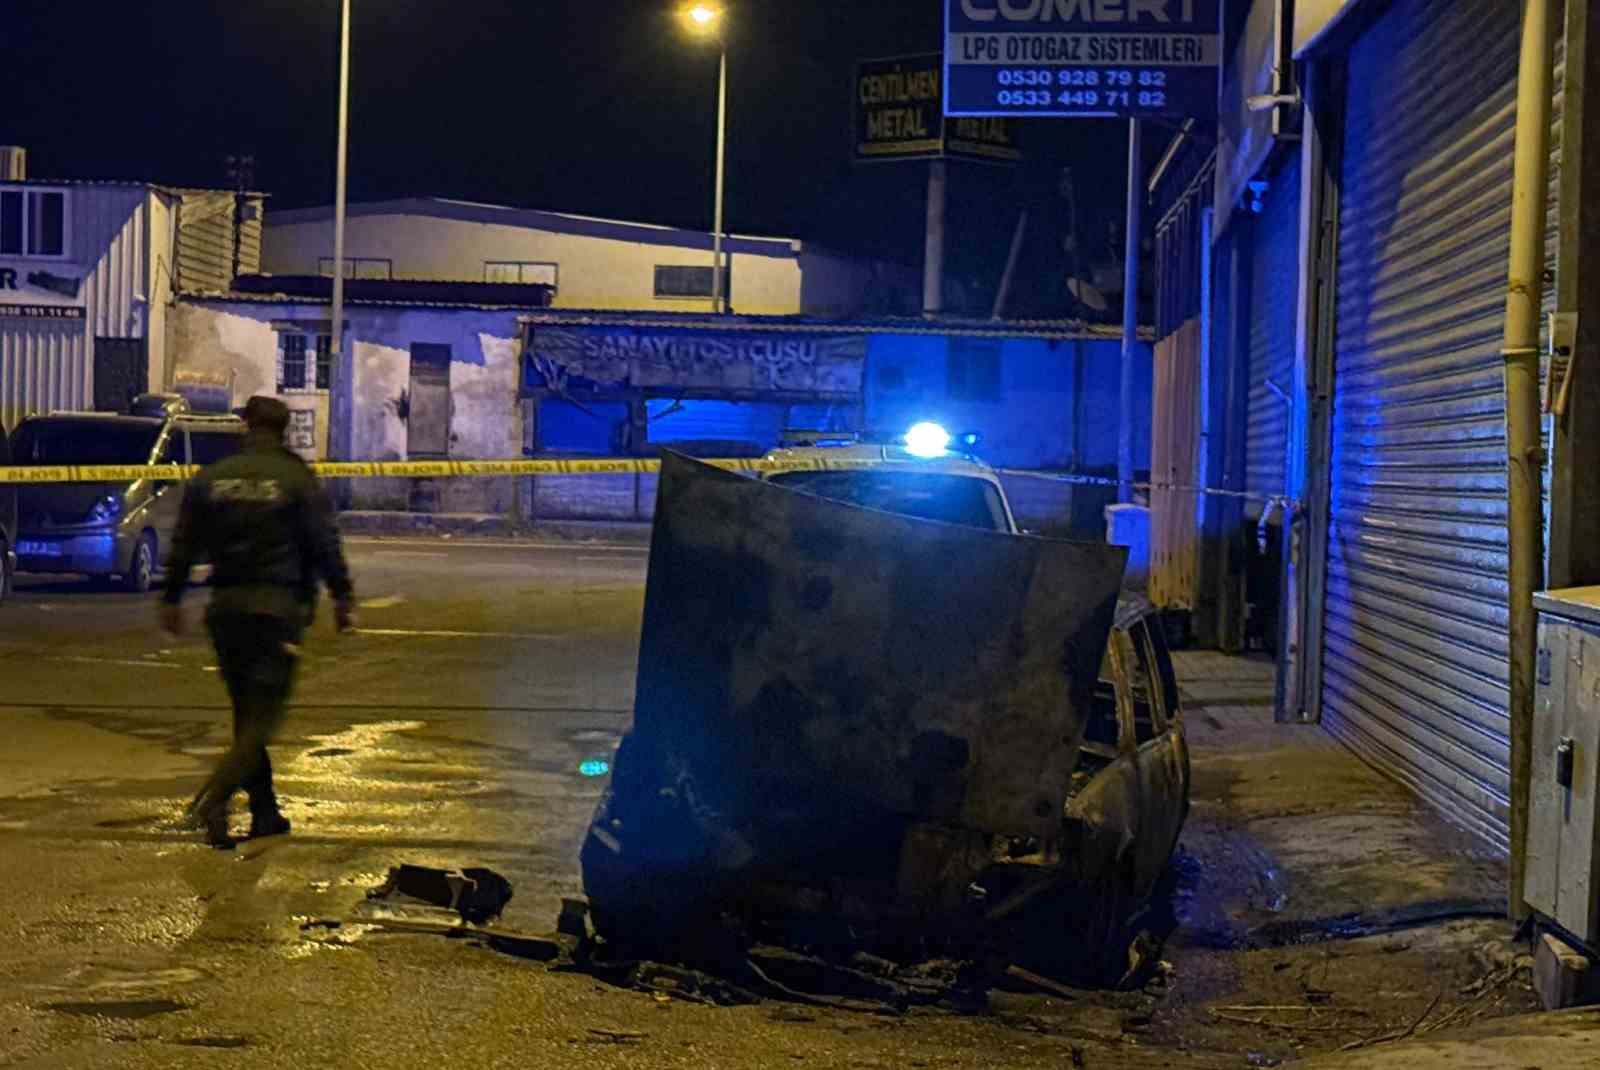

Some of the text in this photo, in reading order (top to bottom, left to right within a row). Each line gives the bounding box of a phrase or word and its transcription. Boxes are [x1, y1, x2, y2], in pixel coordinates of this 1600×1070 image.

[963, 36, 998, 60] LPG
[1006, 36, 1082, 61] OTOGAZ
[997, 70, 1166, 86] 0530 928 79 82
[997, 90, 1166, 106] 0533 449 71 82
[868, 108, 928, 138] METAL
